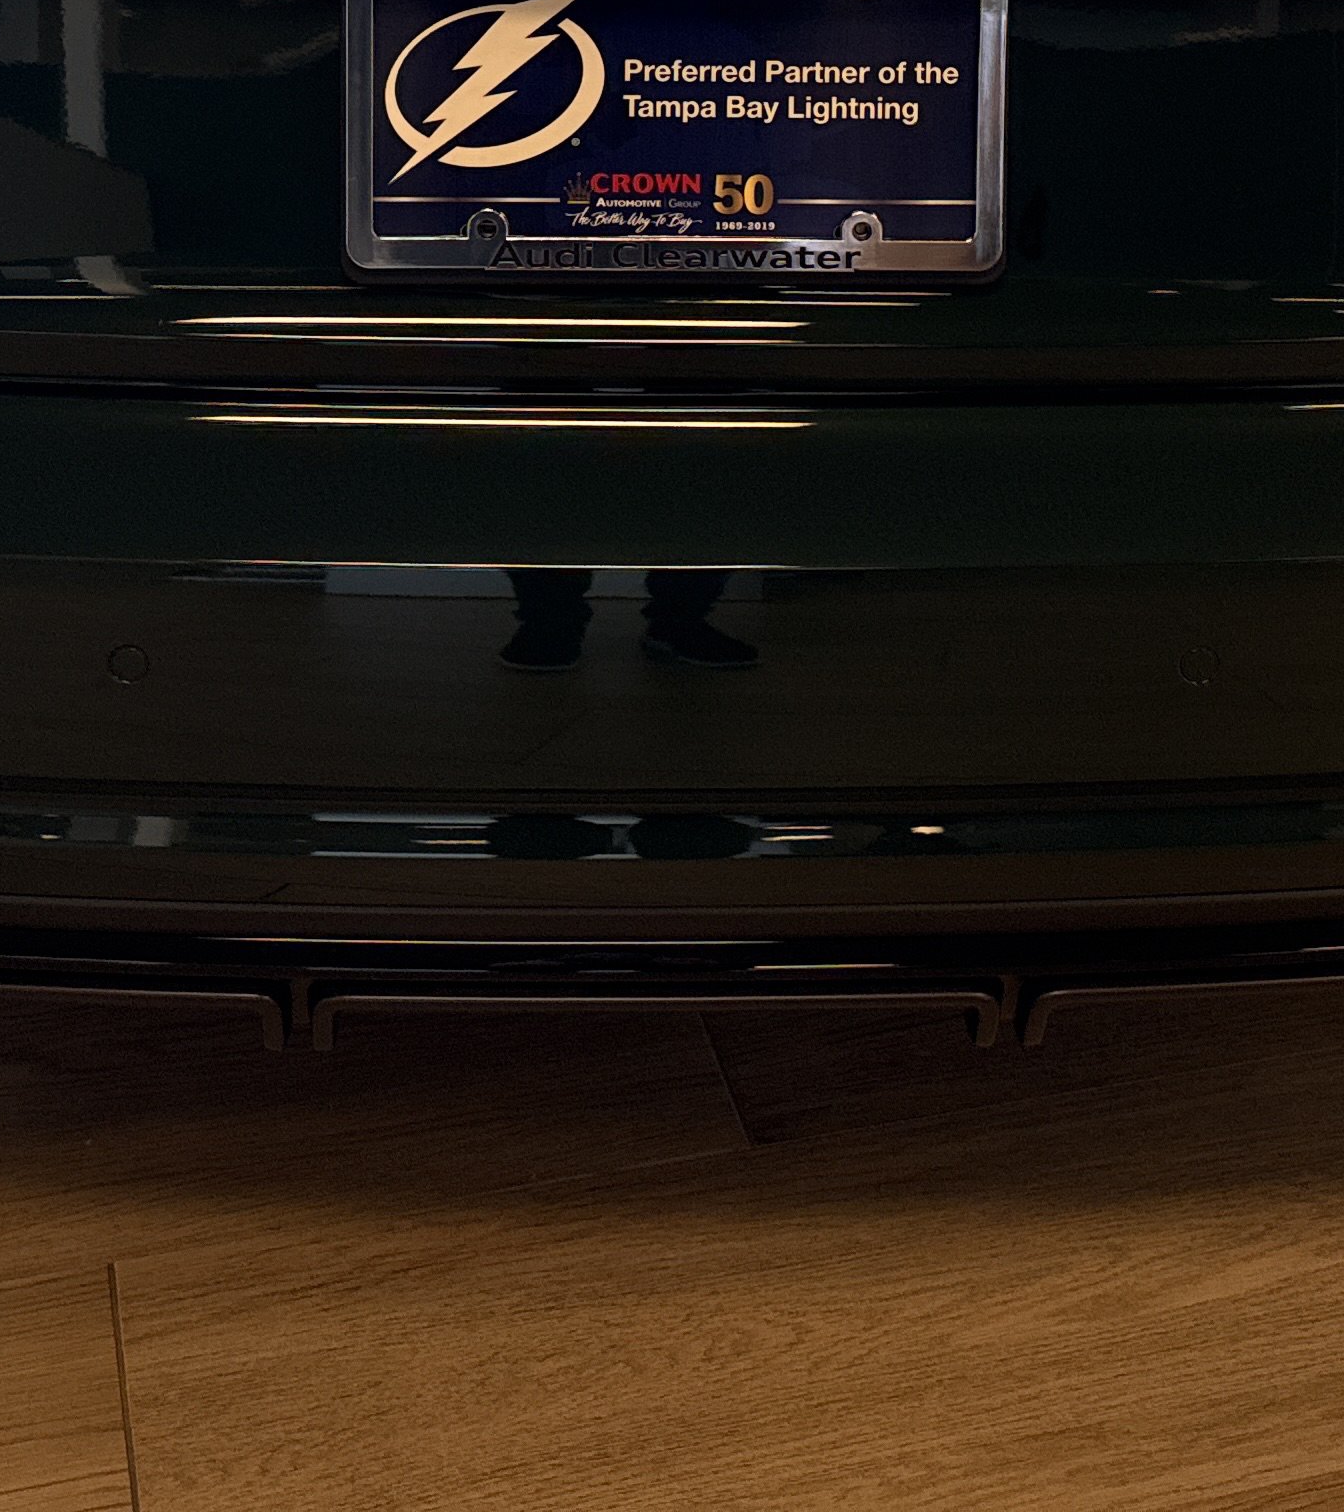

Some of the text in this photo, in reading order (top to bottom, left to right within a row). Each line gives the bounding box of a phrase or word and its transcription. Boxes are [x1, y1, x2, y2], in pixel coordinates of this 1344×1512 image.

[624, 59, 959, 84] Preferred Partner of the
[623, 94, 919, 125] Tampa Bay Lightning
[590, 172, 701, 194] CROWN
[712, 174, 774, 215] 50
[565, 206, 703, 234] The Better Way To Buy
[715, 221, 776, 231] 1969-2019
[490, 242, 861, 270] Audi Clearwater
